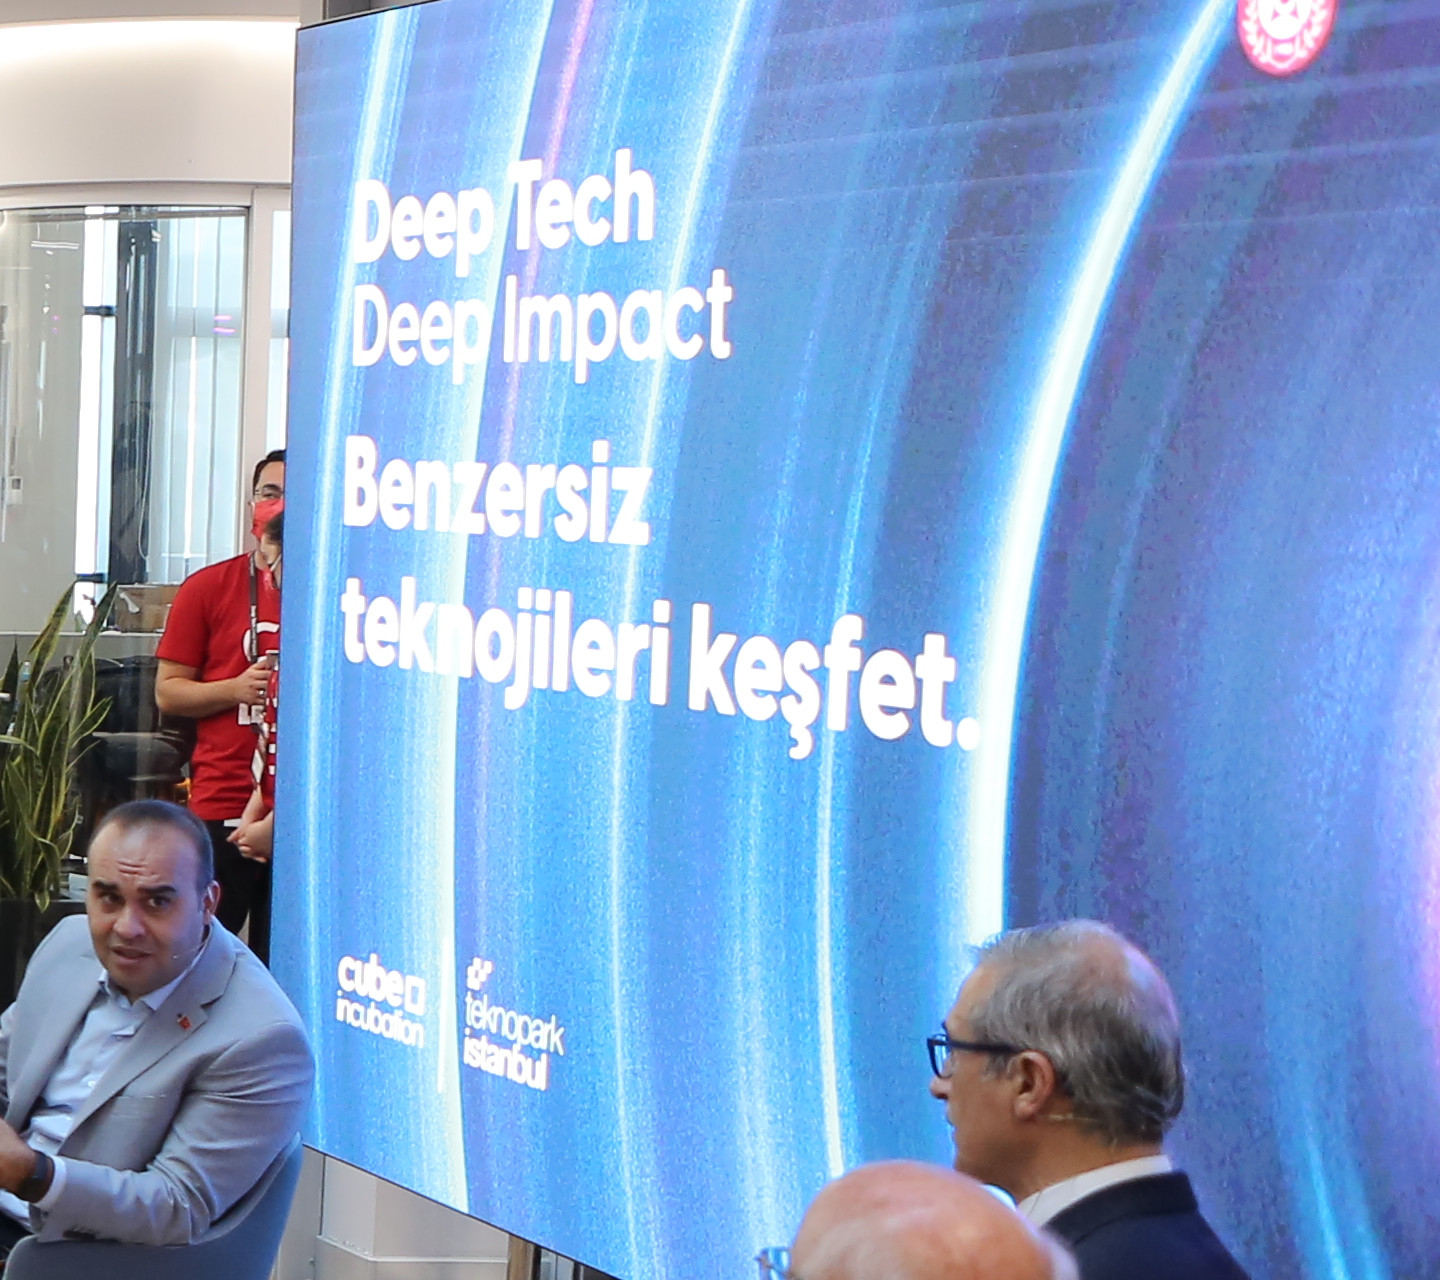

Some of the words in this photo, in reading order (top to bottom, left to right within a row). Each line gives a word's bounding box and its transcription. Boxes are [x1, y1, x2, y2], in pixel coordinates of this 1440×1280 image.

[352, 177, 495, 277] Deep
[505, 148, 654, 256] Tech
[350, 283, 491, 387] Deep
[502, 267, 733, 383] Impact
[342, 435, 652, 546] Benzersiz
[340, 578, 672, 709] teknojileri
[688, 602, 982, 759] keşfet.
[335, 989, 424, 1049] incubation
[337, 952, 404, 1007] cube
[464, 989, 566, 1056] teknopark
[462, 1026, 549, 1091] istanbul
